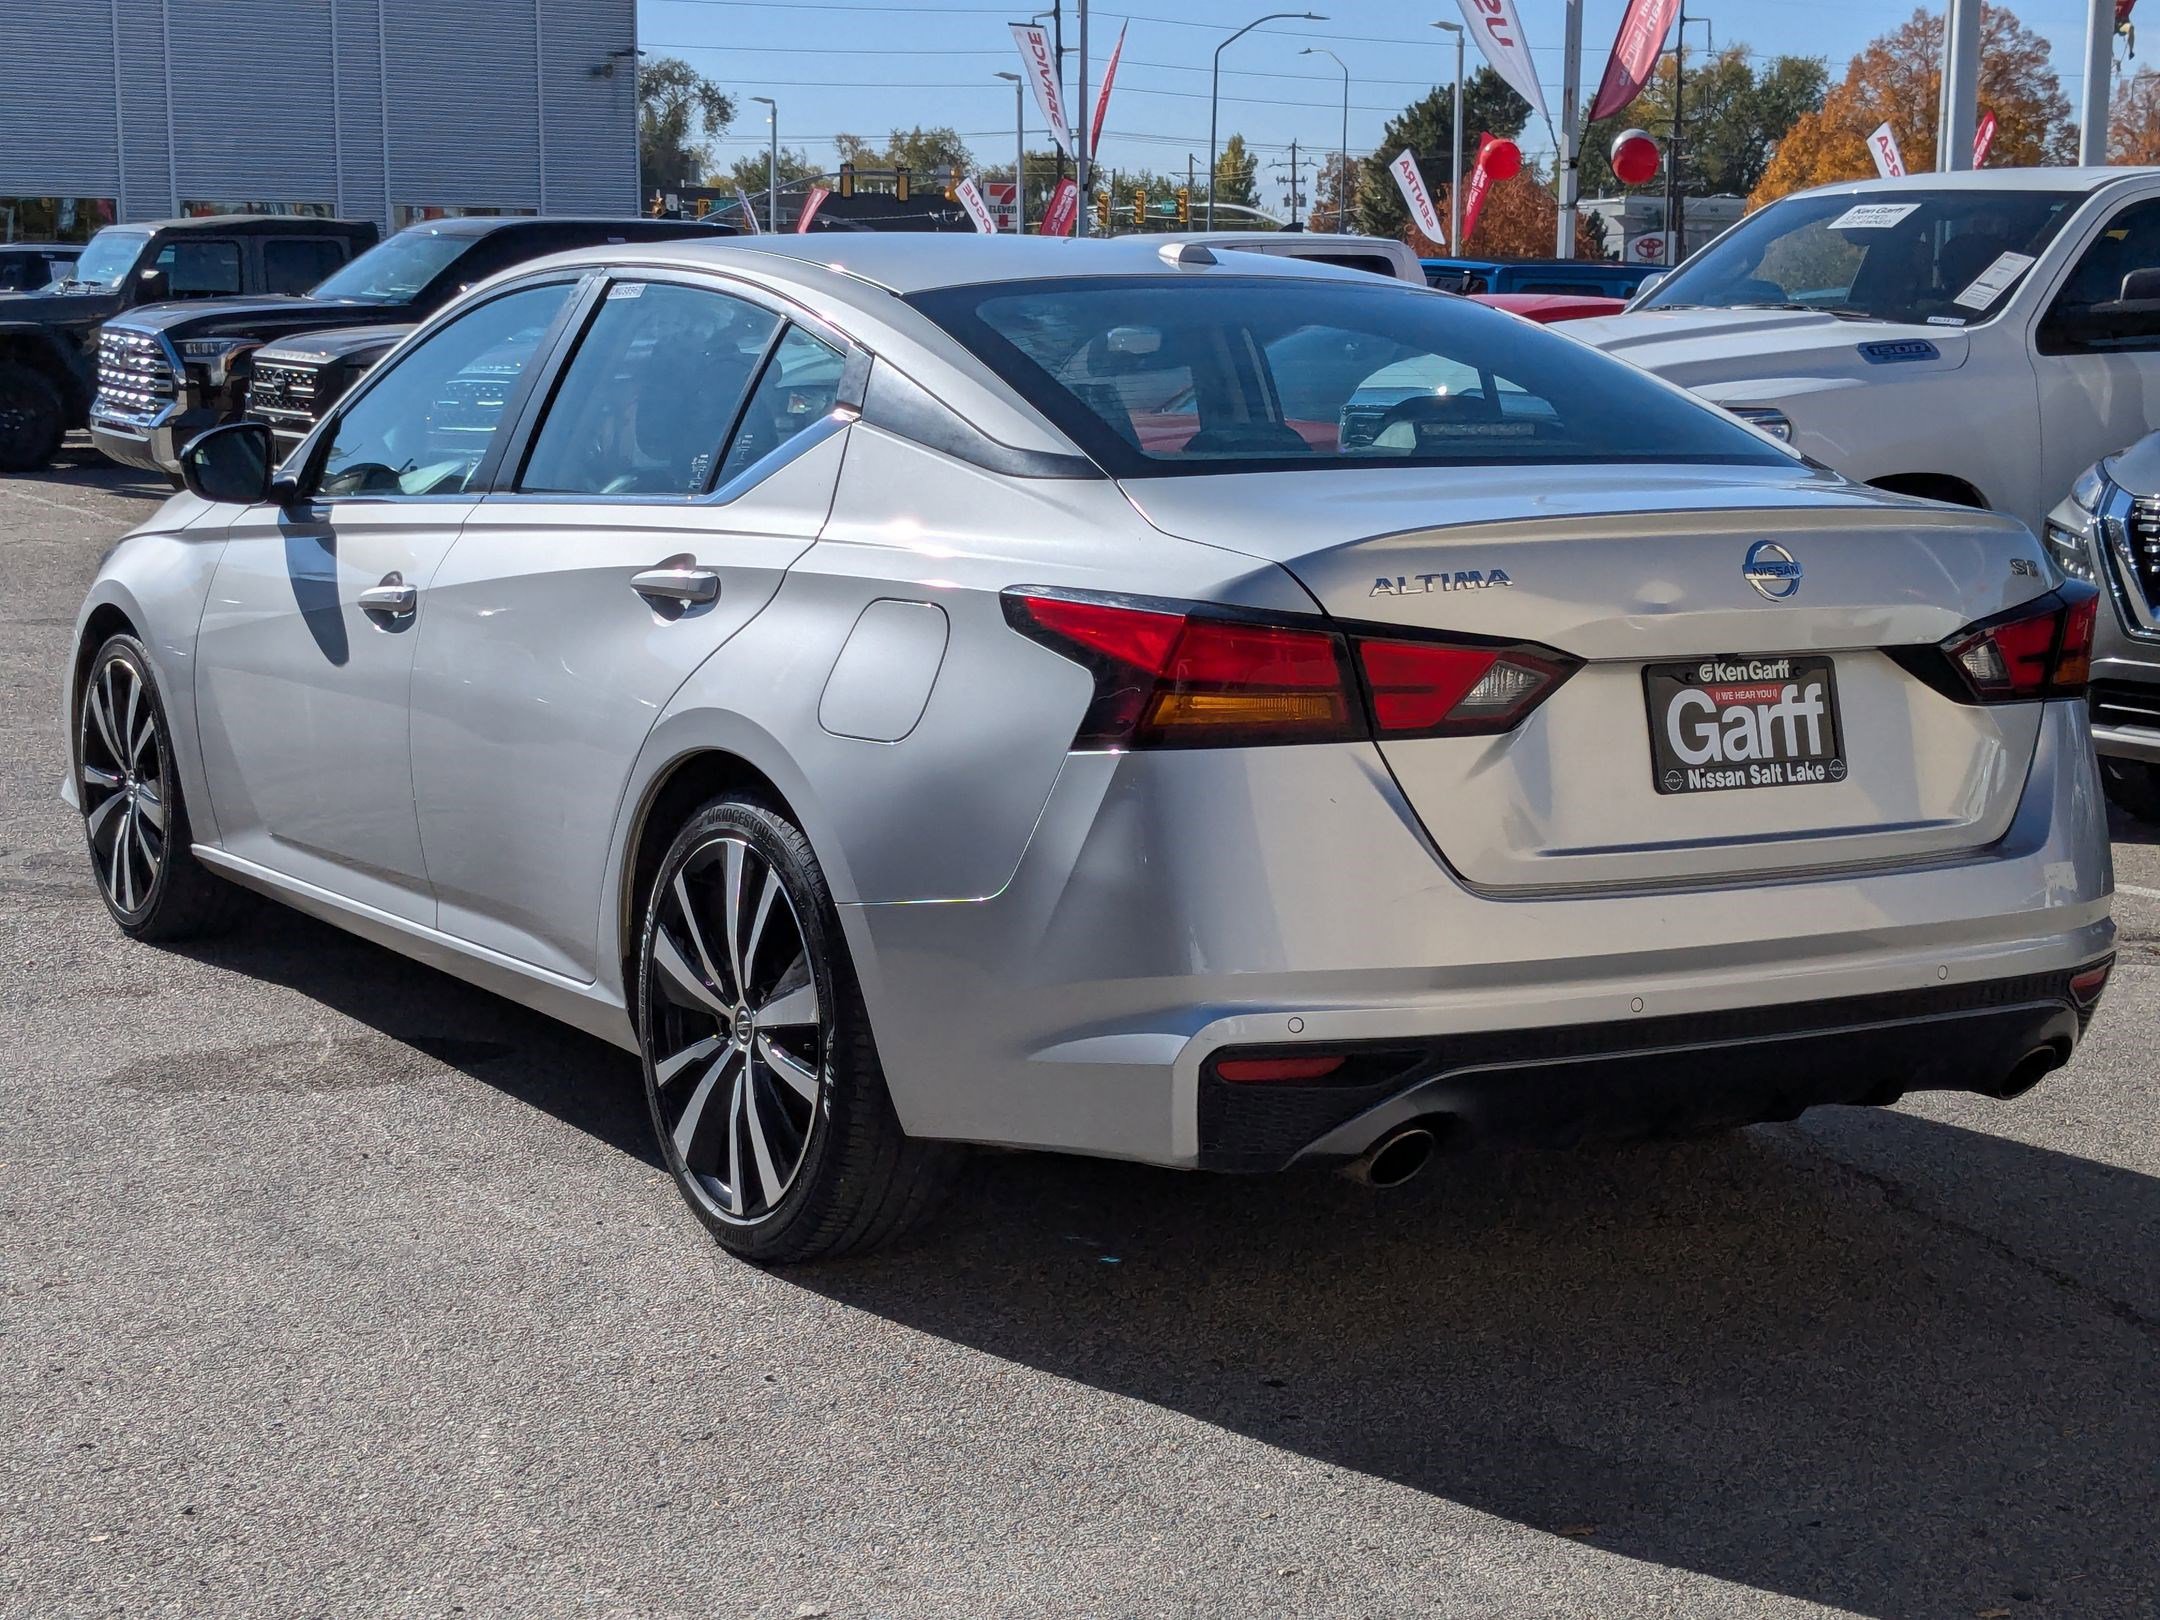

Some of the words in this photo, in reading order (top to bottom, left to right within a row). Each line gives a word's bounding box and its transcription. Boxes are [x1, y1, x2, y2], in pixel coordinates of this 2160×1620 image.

[1752, 565, 1800, 578] NISSAN
[2010, 558, 2039, 577] SR
[1369, 568, 1514, 598] ALTIMA
[1714, 662, 1748, 682] Ken
[1749, 659, 1790, 681] Garff
[1721, 691, 1734, 700] WE
[1735, 690, 1756, 699] HEAR
[1756, 689, 1772, 698] YOU
[1666, 683, 1824, 765] Garff
[1687, 767, 1746, 790] Nissan
[1749, 763, 1783, 785] Salt
[1787, 761, 1825, 782] Lake
